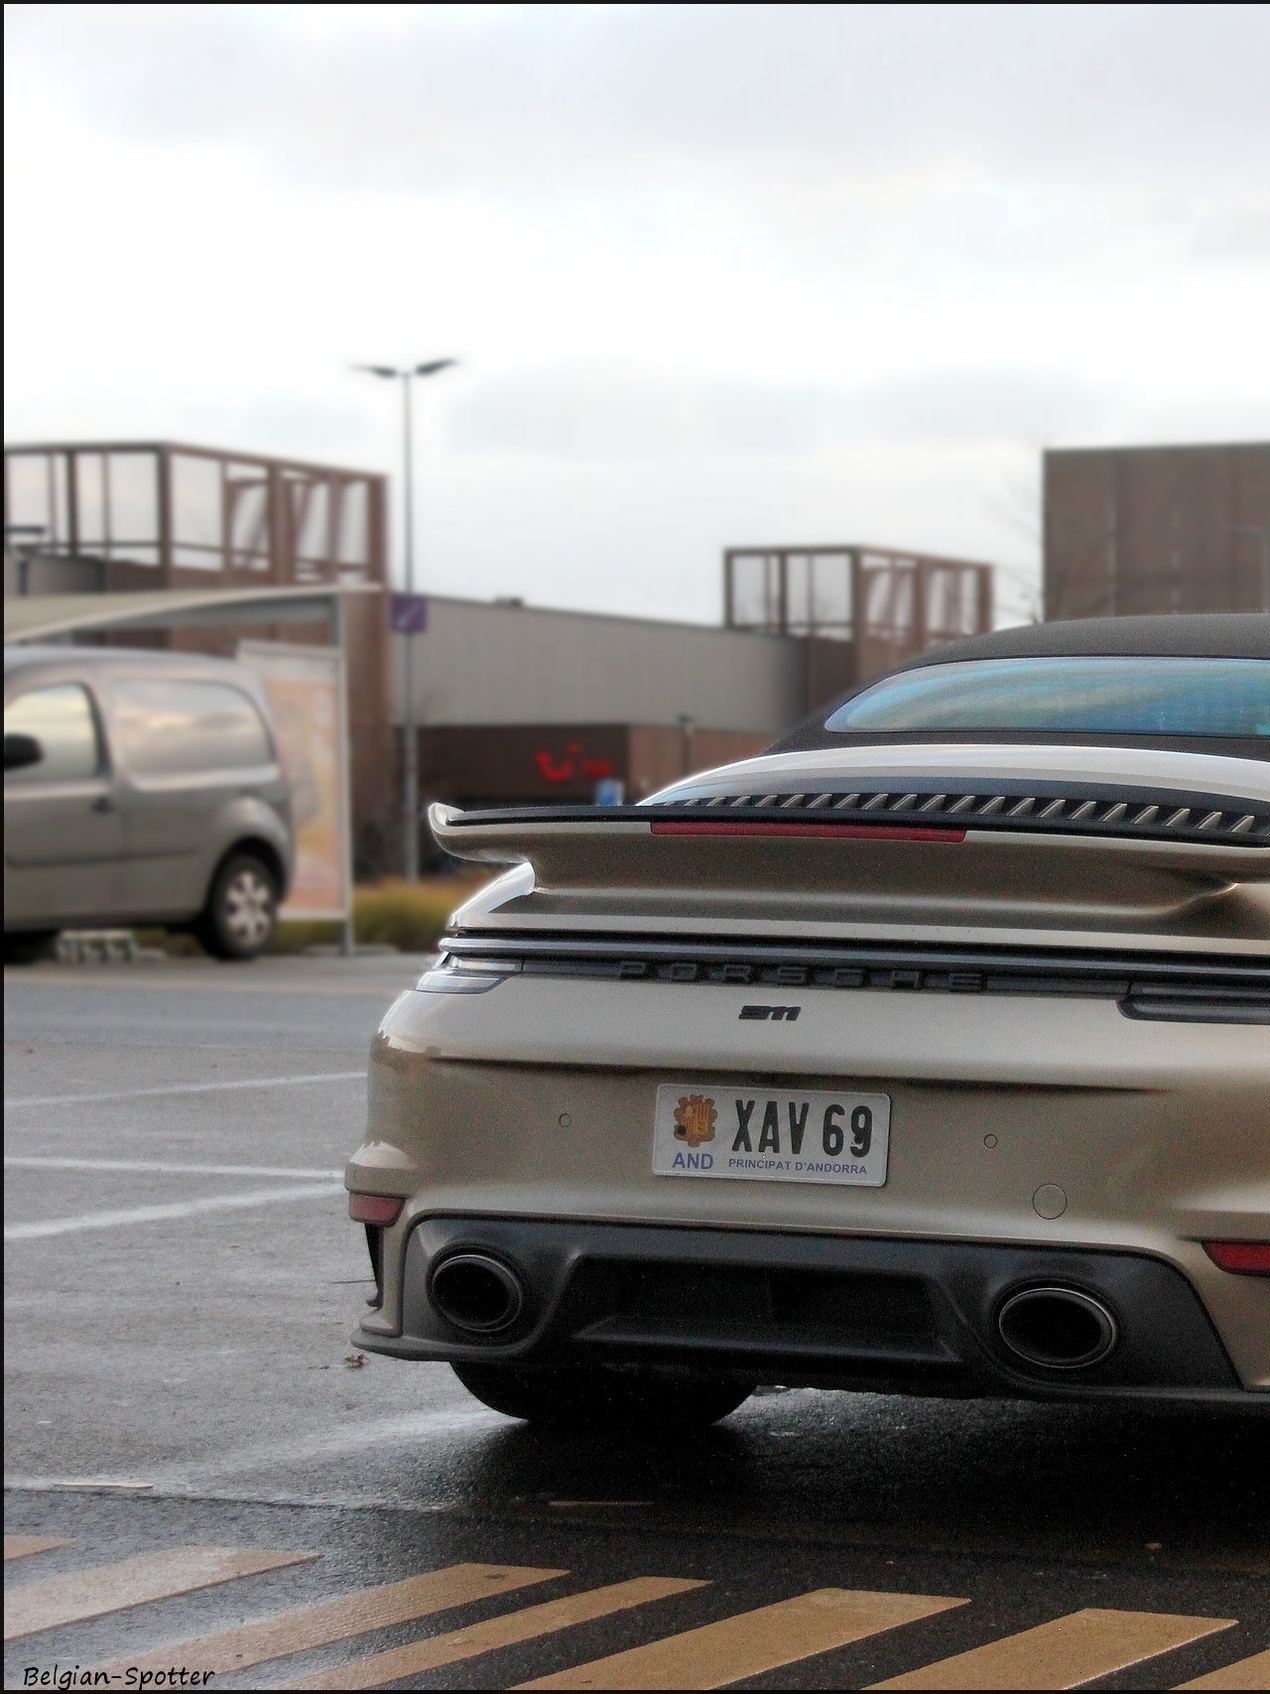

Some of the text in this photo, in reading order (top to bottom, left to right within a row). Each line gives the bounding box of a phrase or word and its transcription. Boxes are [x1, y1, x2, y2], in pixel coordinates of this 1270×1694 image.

[619, 960, 983, 992] PORSCHE
[731, 1099, 873, 1158] XAV 69
[672, 1152, 715, 1170] AND
[728, 1158, 868, 1175] PRINCIPAT D'ANDORRA
